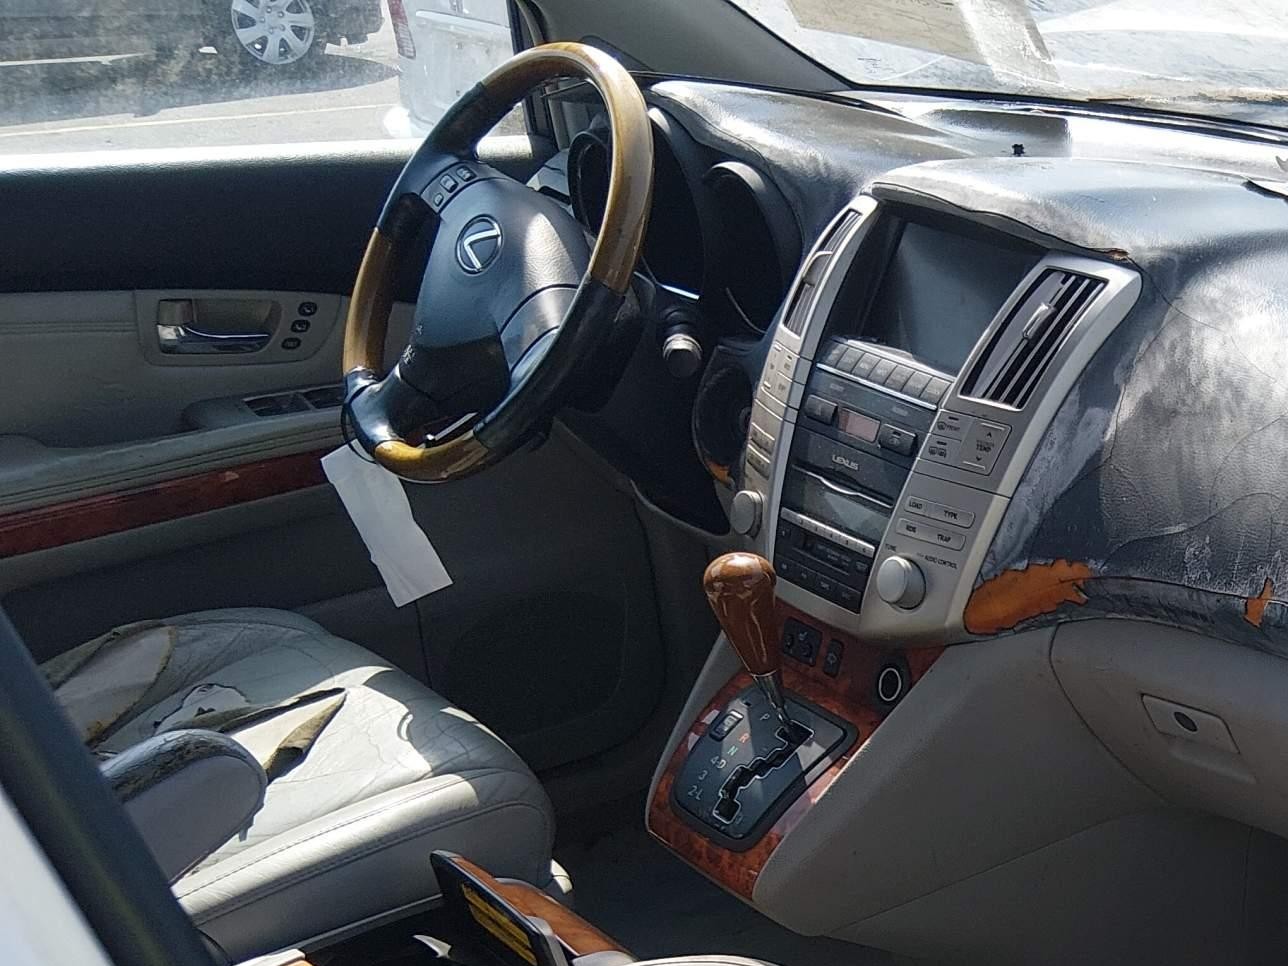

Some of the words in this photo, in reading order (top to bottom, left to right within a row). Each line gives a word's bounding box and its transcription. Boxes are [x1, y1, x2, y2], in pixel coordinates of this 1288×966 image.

[832, 454, 858, 470] LEXUS
[908, 500, 922, 509] LOAD
[944, 510, 958, 519] TYPE
[760, 712, 770, 721] P
[739, 732, 750, 743] R
[727, 745, 738, 756] N
[698, 769, 708, 781] 3
